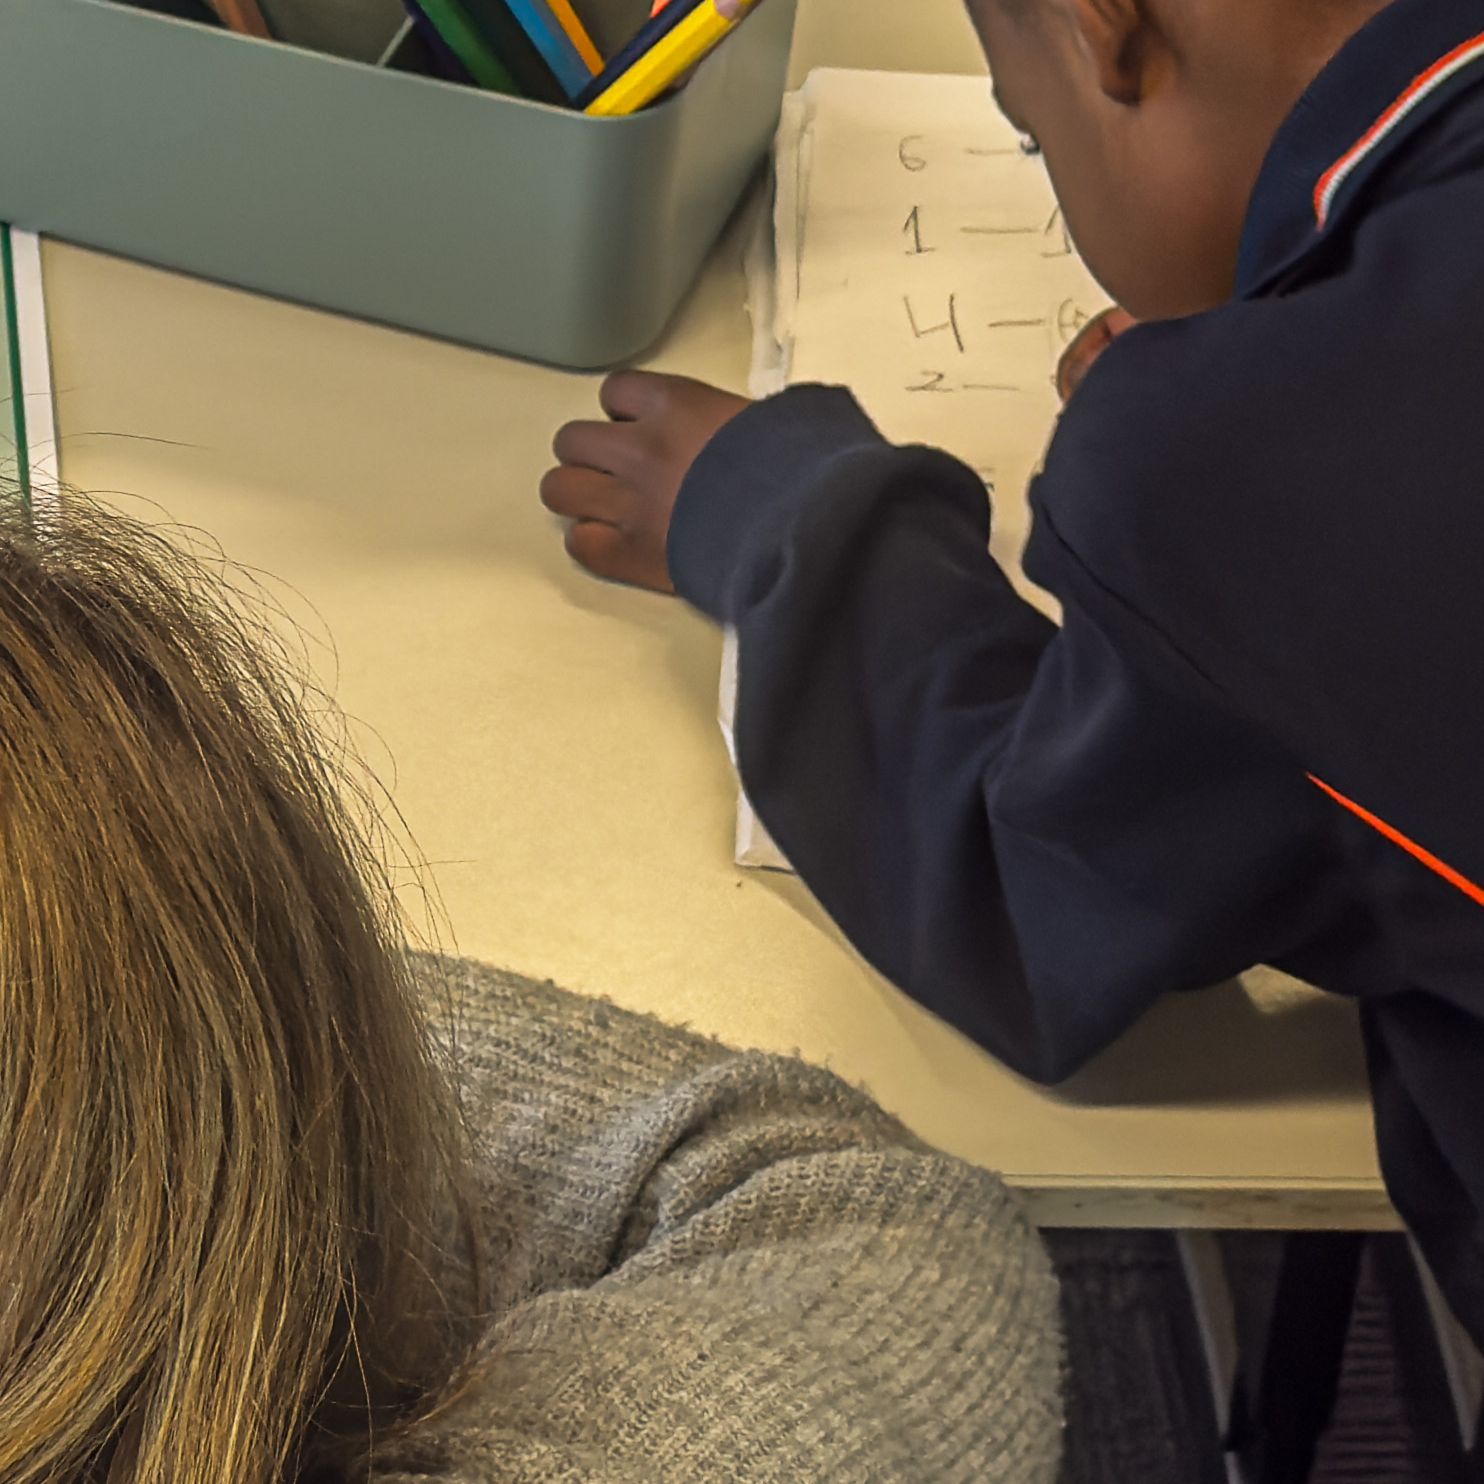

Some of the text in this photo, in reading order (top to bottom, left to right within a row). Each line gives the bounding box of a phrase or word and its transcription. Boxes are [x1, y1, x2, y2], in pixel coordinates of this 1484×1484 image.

[899, 134, 928, 172] 6
[902, 204, 937, 255] 1
[903, 292, 964, 353] 4
[905, 369, 954, 393] 2
